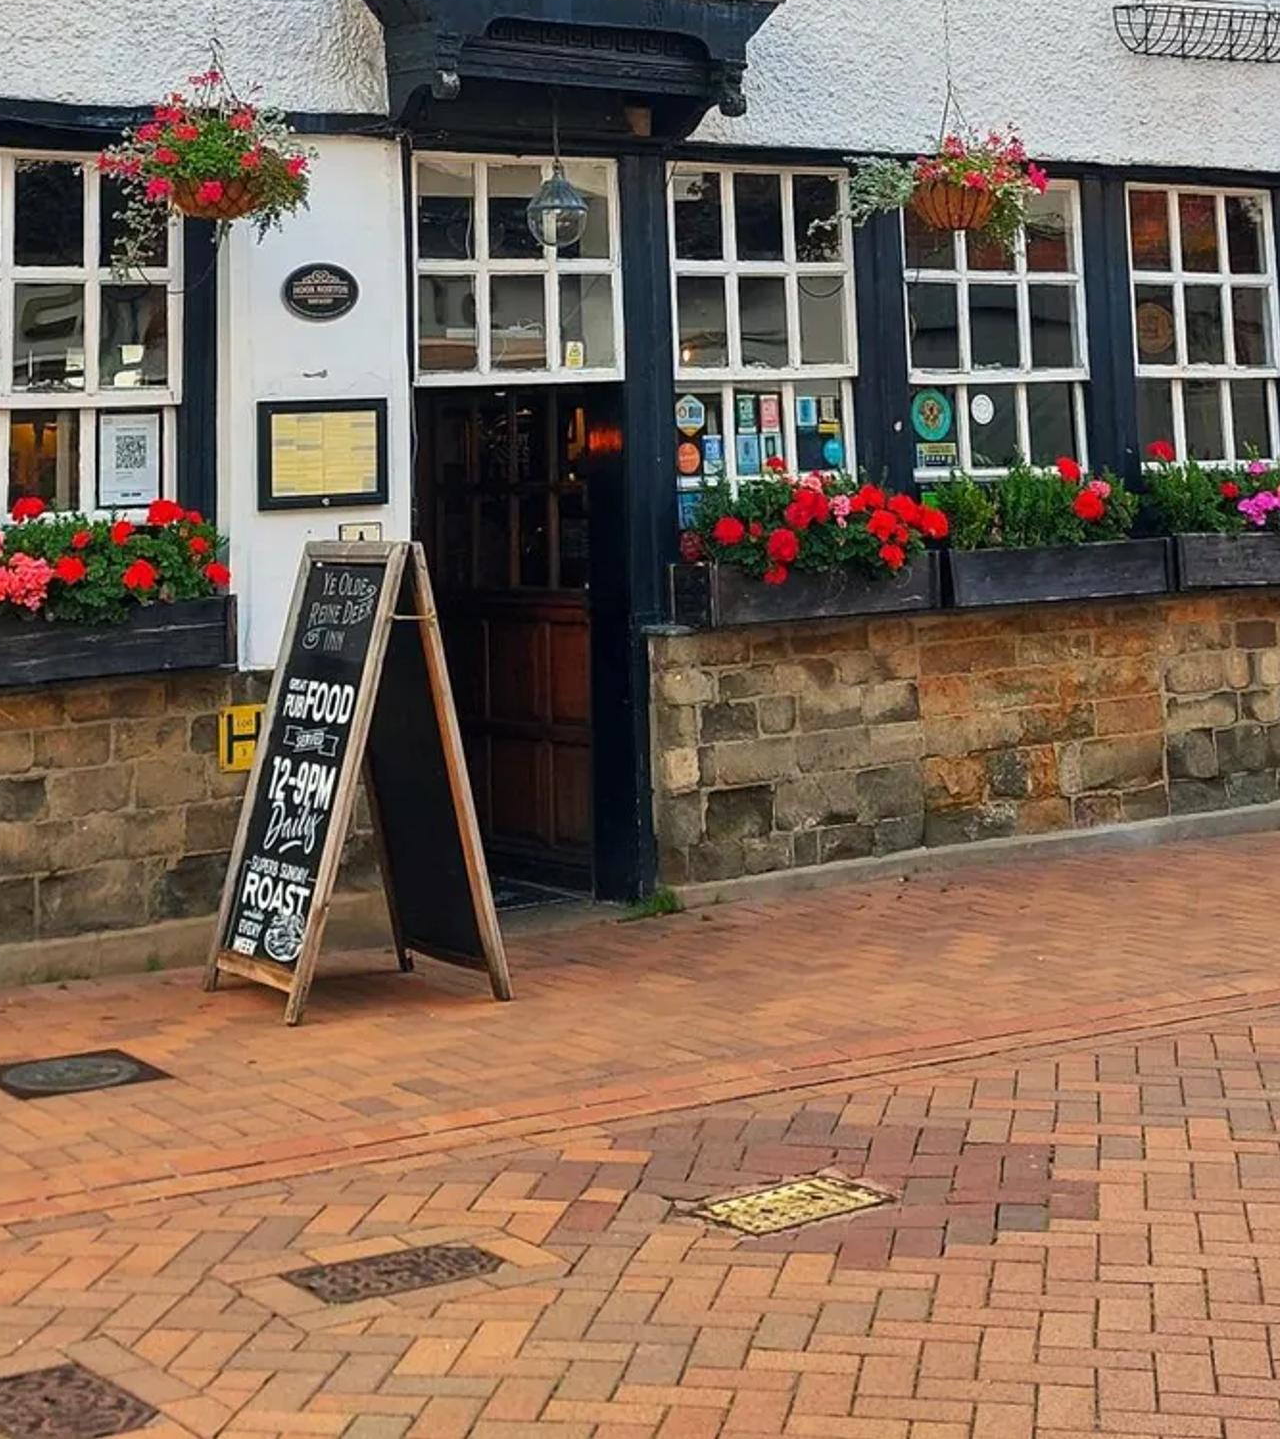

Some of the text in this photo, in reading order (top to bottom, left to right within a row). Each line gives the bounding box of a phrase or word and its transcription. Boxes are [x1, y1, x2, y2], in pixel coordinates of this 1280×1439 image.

[308, 602, 341, 628] REINE
[323, 630, 345, 651] INN
[302, 680, 355, 724] FOOD
[268, 756, 336, 810] 12-9PM
[263, 802, 324, 855] Daily
[241, 871, 310, 915] ROAST
